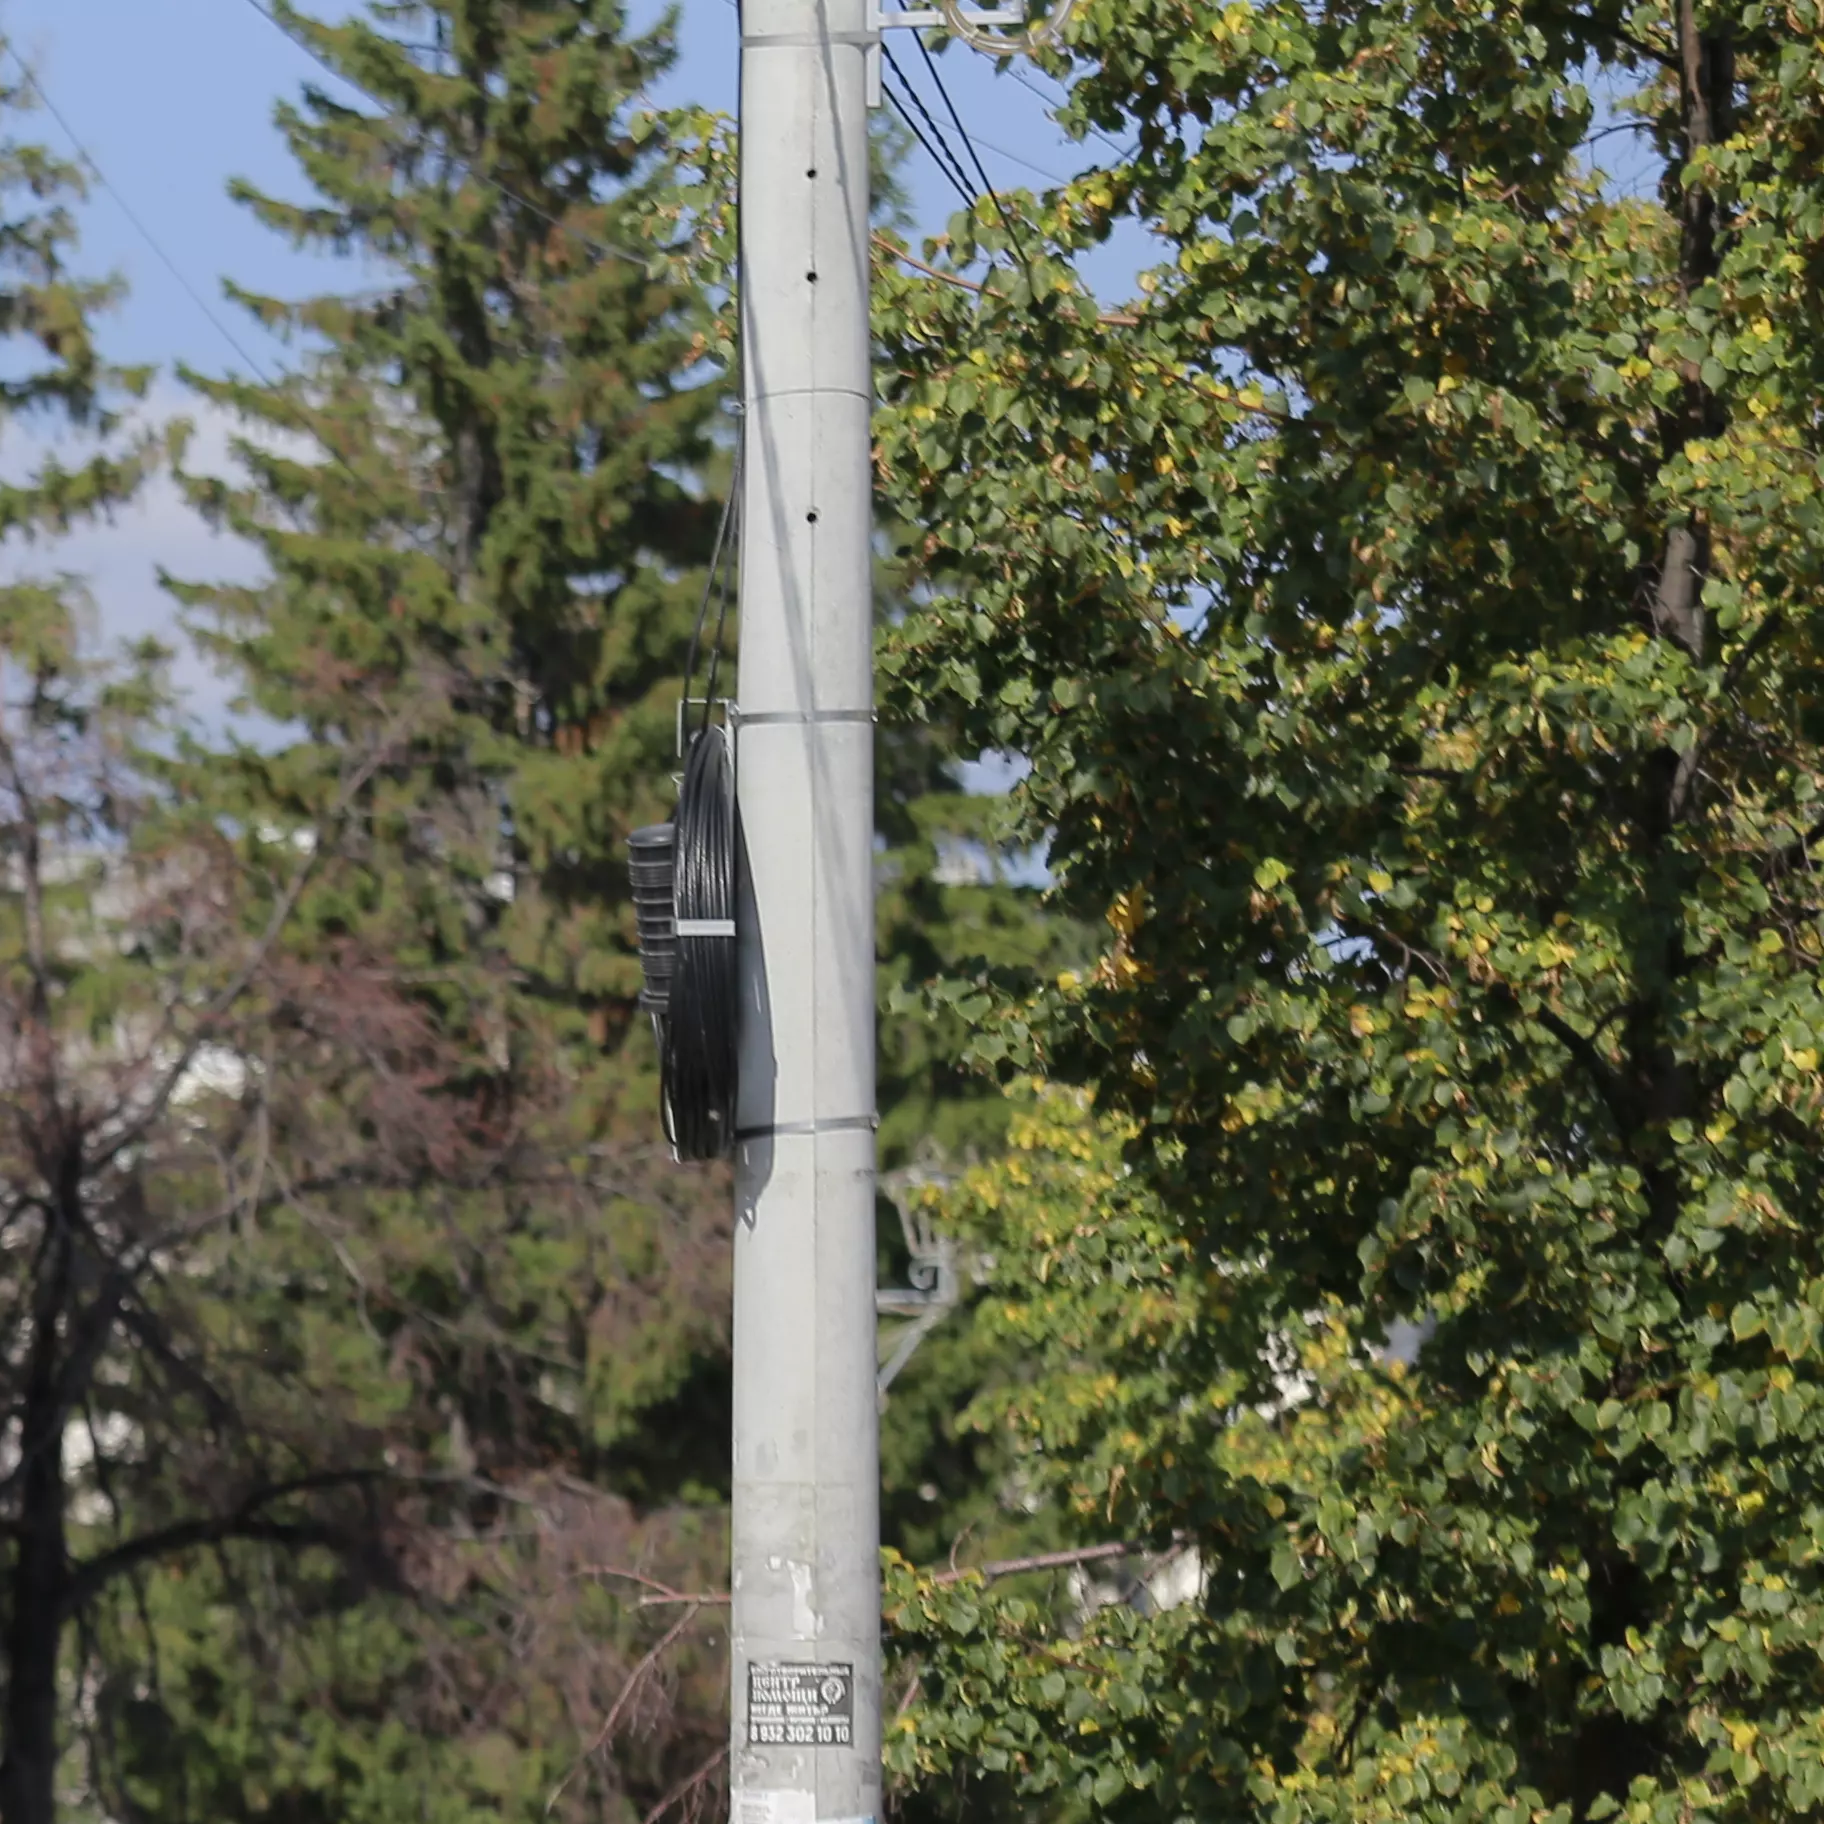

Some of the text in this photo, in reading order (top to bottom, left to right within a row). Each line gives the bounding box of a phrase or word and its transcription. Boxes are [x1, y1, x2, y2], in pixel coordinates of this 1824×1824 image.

[750, 1725, 850, 1743] 8 932 302 10 10
